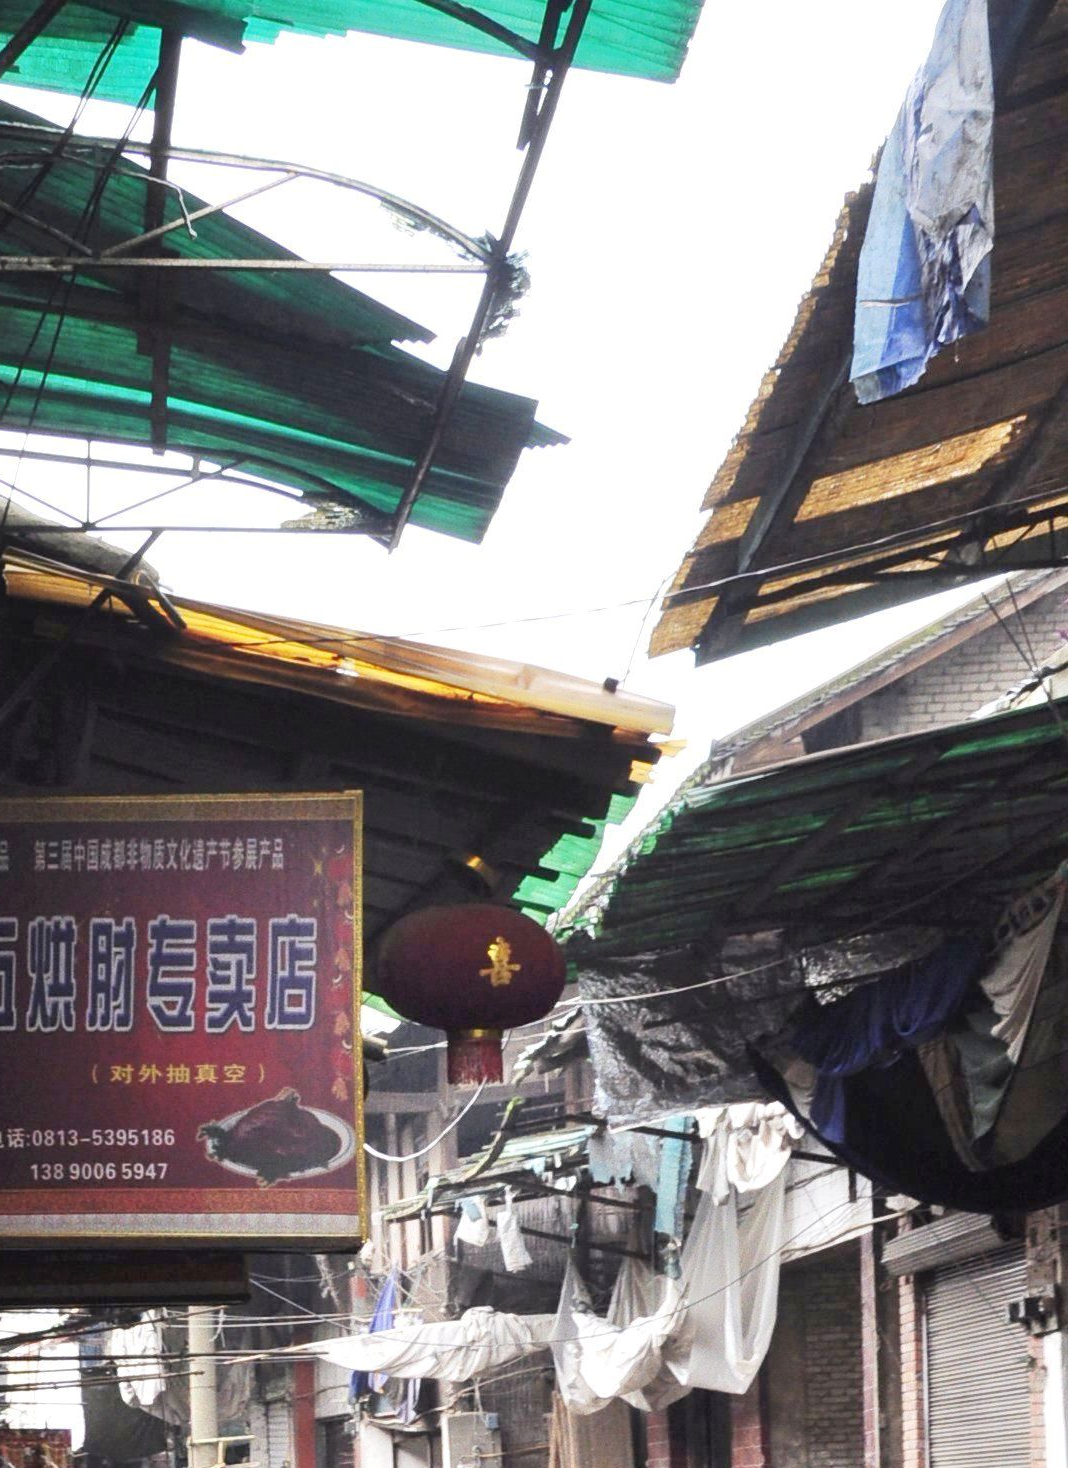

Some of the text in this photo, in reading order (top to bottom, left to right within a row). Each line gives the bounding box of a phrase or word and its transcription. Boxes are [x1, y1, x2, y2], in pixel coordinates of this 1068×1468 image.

[30, 1162, 169, 1181] 138 9006 5947
